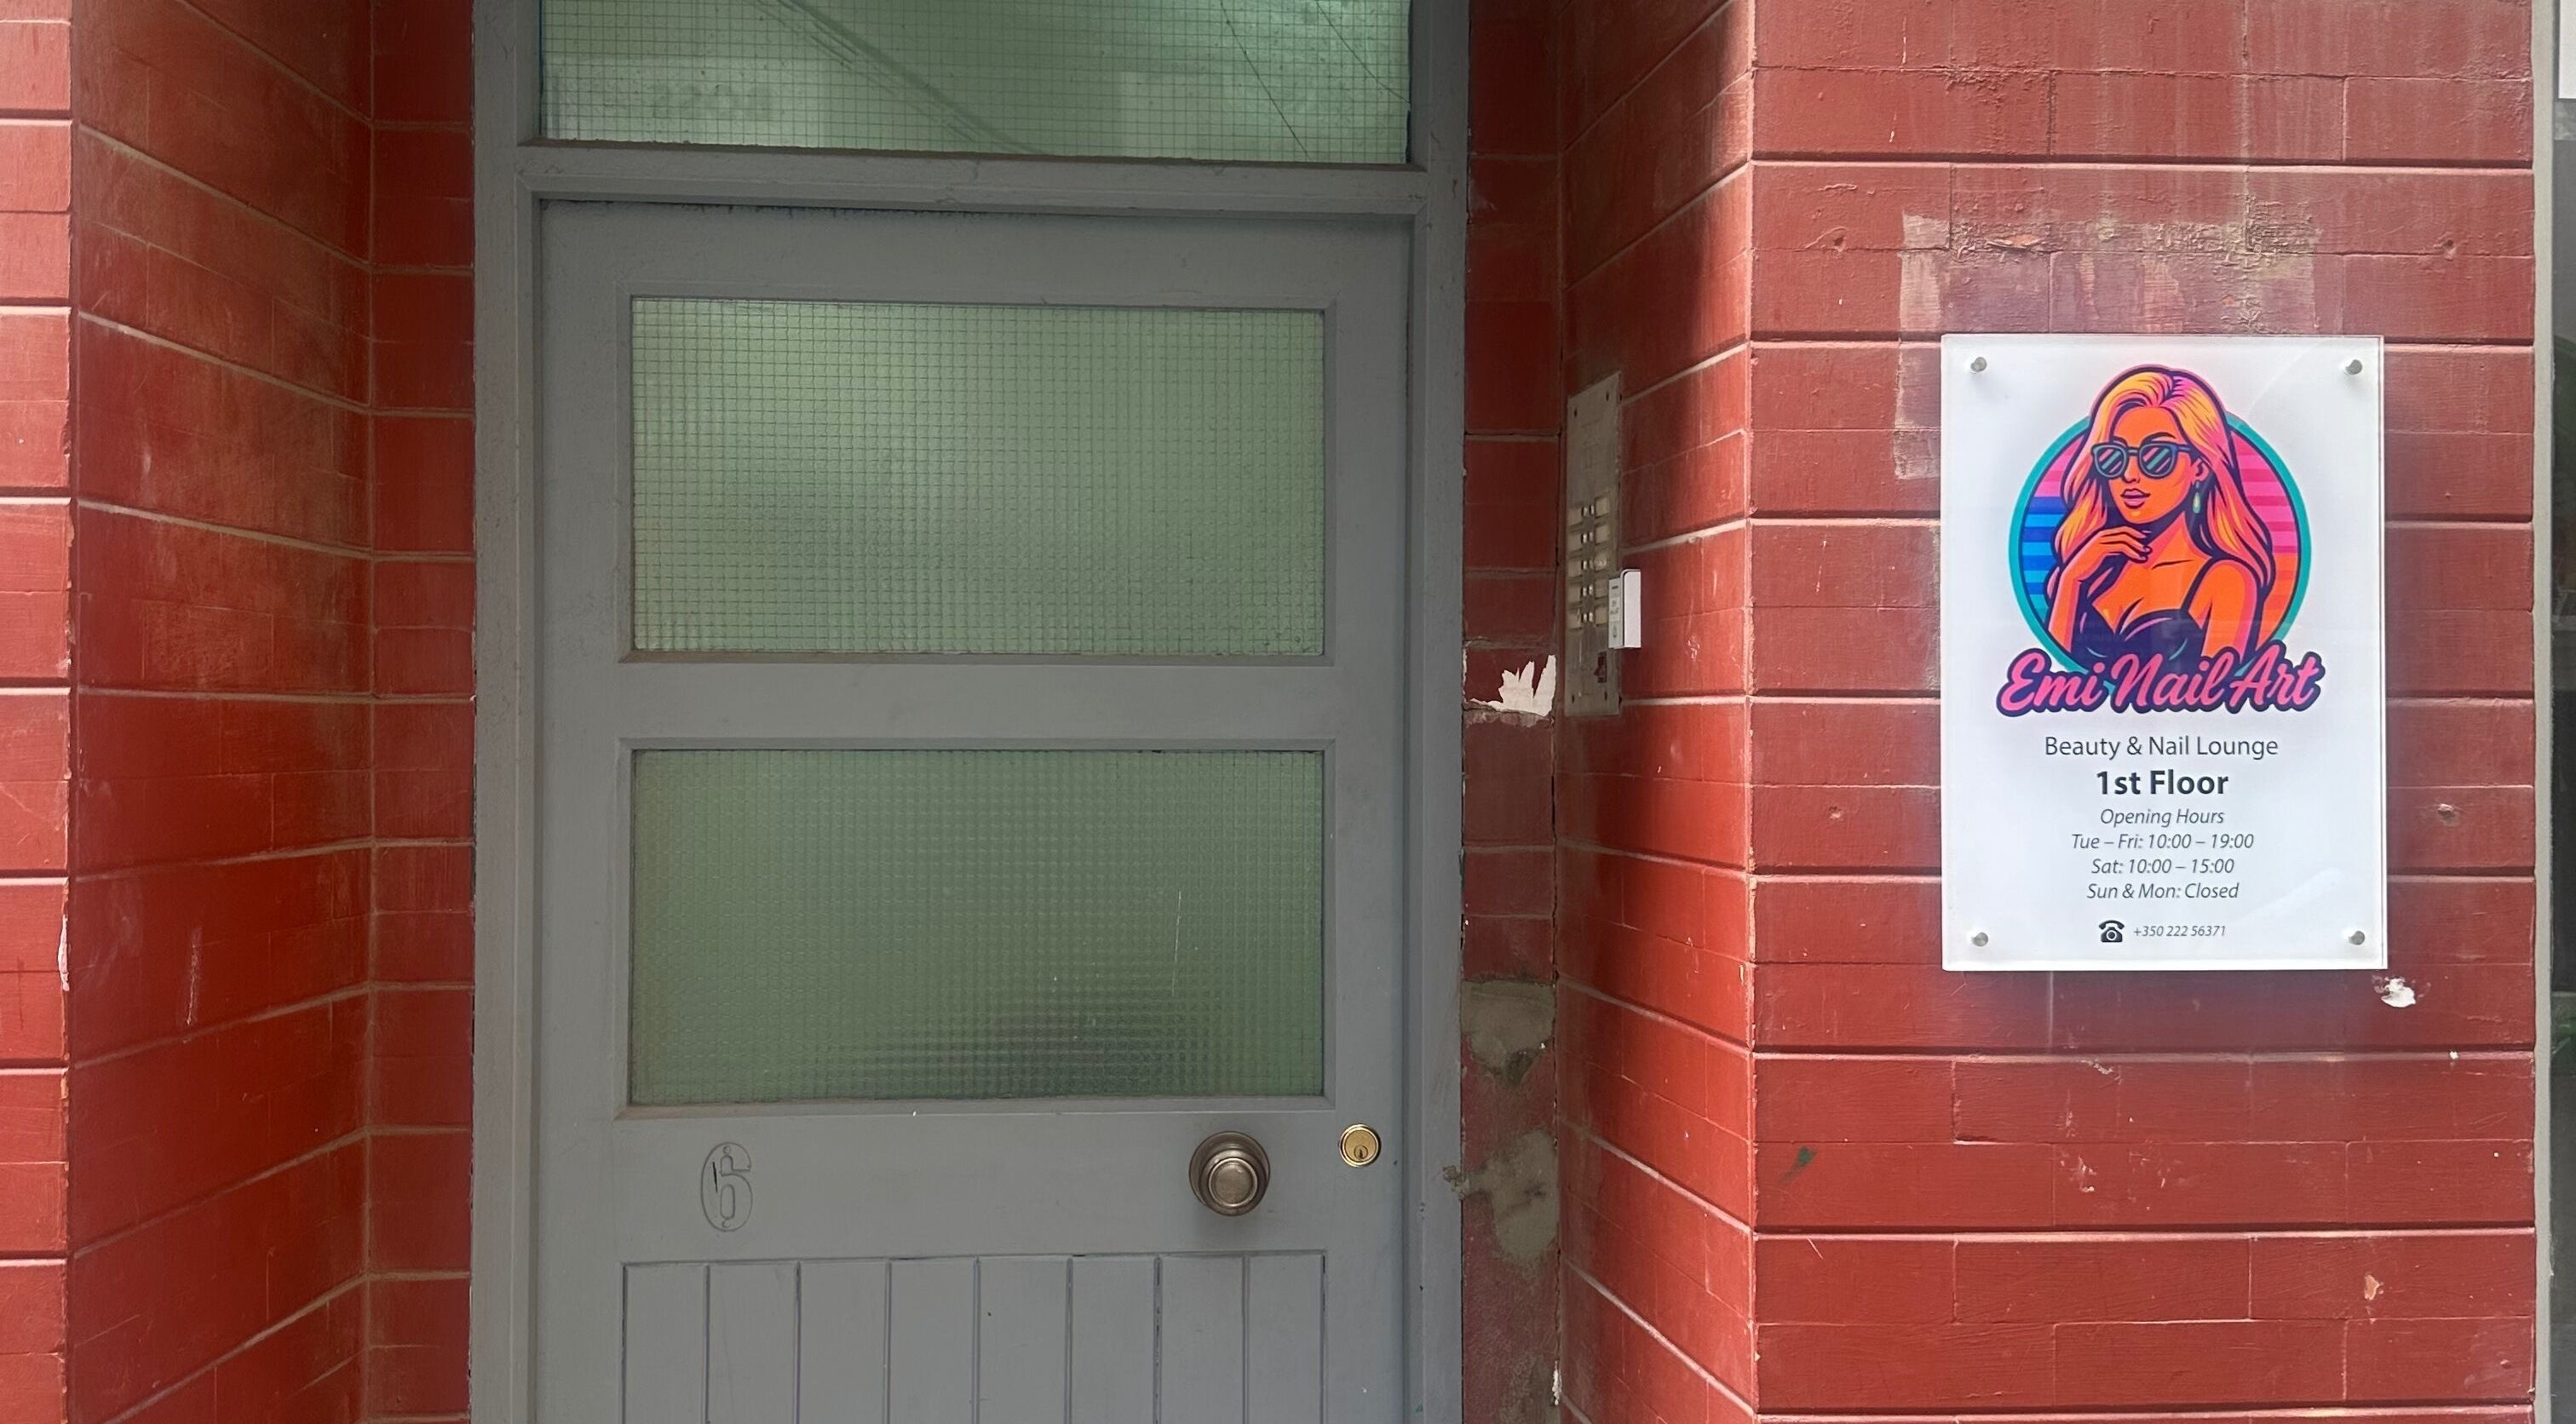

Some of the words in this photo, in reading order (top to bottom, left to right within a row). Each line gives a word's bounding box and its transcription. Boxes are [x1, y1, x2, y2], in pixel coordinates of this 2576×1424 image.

[1999, 651, 2106, 713] Emi
[2110, 651, 2231, 709] Nail
[2229, 643, 2322, 709] Art
[2044, 736, 2122, 761] Beauty
[2126, 736, 2143, 756] &
[2148, 734, 2190, 756] Nail
[2196, 735, 2280, 761] Lounge
[2096, 770, 2142, 795] 1st
[2149, 768, 2229, 795] Floor
[2100, 807, 2172, 829] Opening
[2176, 807, 2225, 824] Hours
[2071, 833, 2101, 850] Tue
[2117, 833, 2144, 850] Fri:
[2148, 833, 2193, 850] 10:00
[2211, 833, 2255, 850] 19:00
[2090, 858, 2124, 875] Sat:
[2129, 858, 2172, 875] 10:00
[2191, 858, 2235, 875] 15:00
[2085, 882, 2119, 899] Sun
[2121, 882, 2136, 899] &
[2137, 882, 2182, 899] Mon:
[2184, 881, 2240, 899] Closed
[2133, 925, 2165, 938] +350
[2165, 925, 2189, 937] 222
[2190, 925, 2226, 937] 56371
[700, 1140, 754, 1232] 6
